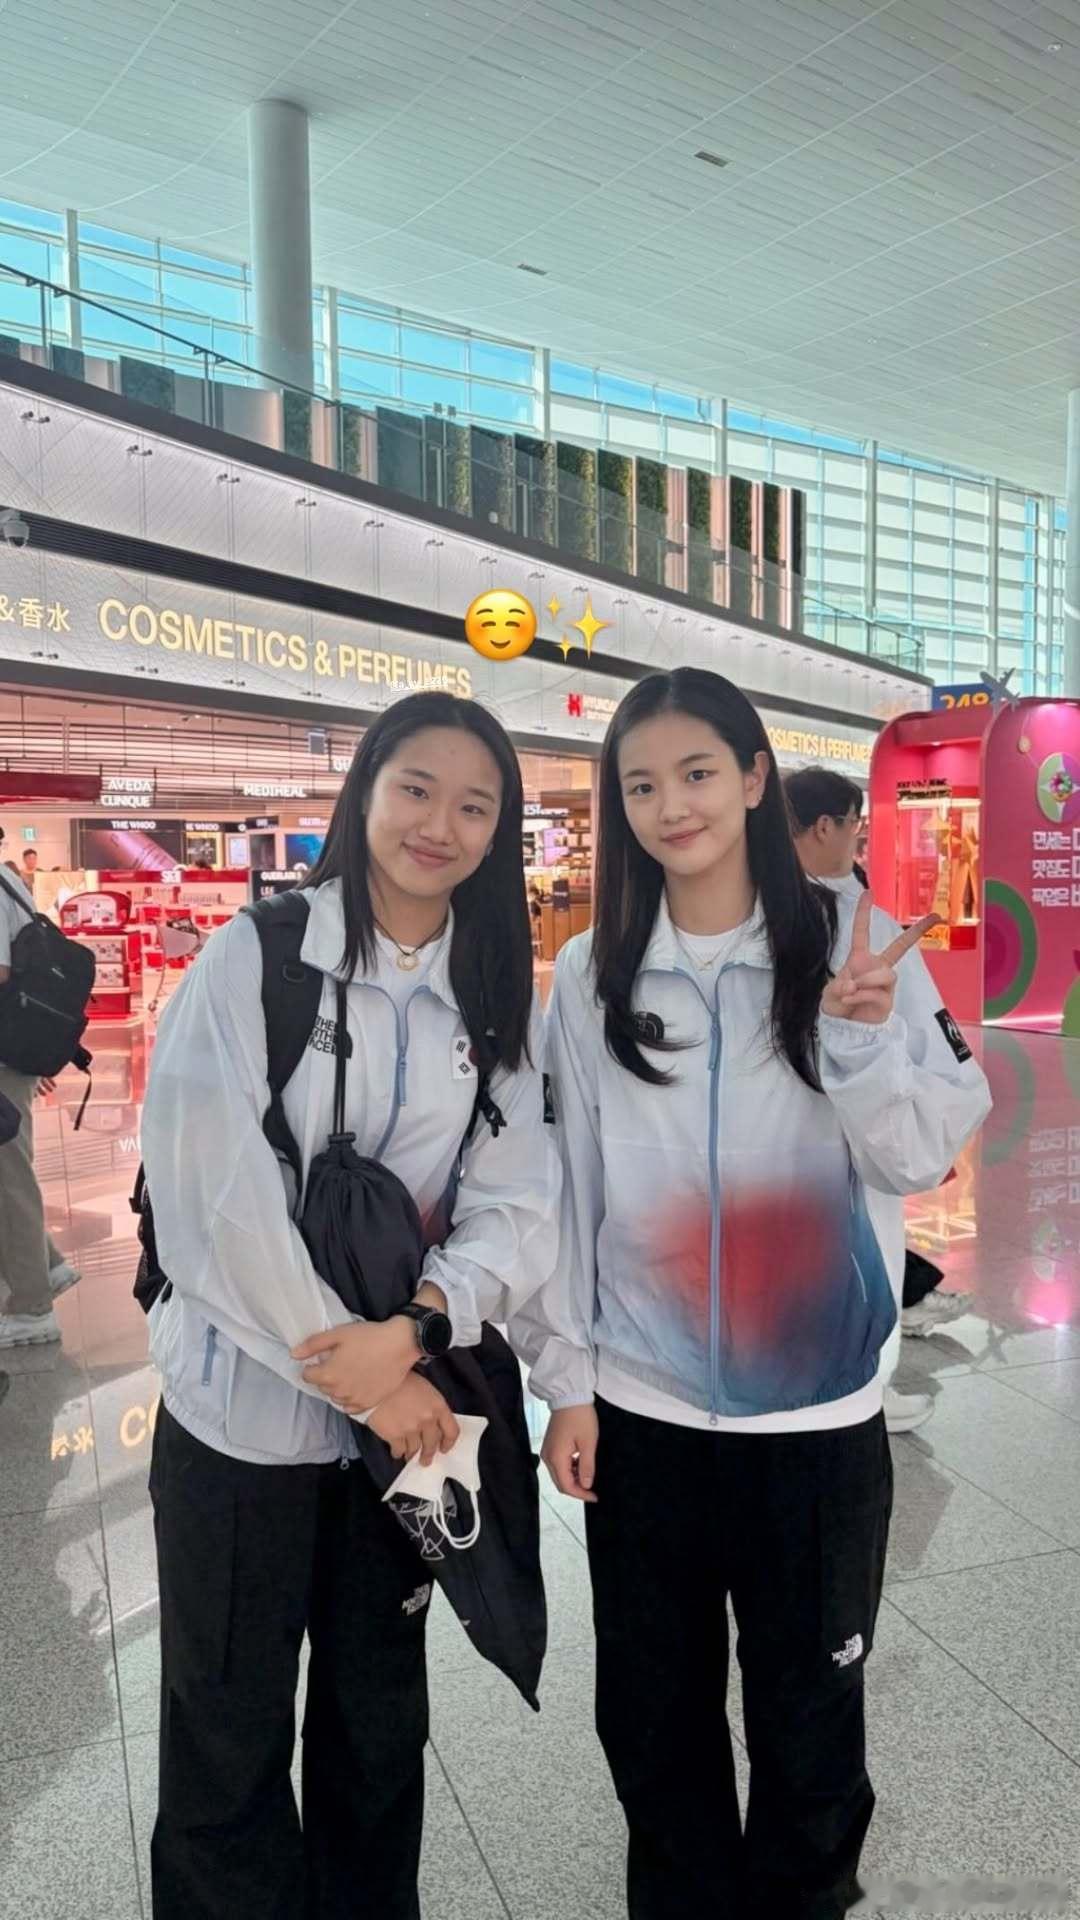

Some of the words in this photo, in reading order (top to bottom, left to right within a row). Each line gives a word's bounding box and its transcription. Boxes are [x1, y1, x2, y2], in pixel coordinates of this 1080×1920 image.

[99, 598, 308, 671] COSMETICS
[314, 639, 333, 676] &
[338, 645, 473, 699] PERFUMES
[767, 727, 819, 756] OSMETICS
[107, 779, 153, 792] AVEDA
[101, 794, 151, 808] CLINIQUE
[308, 1041, 332, 1053] ACE
